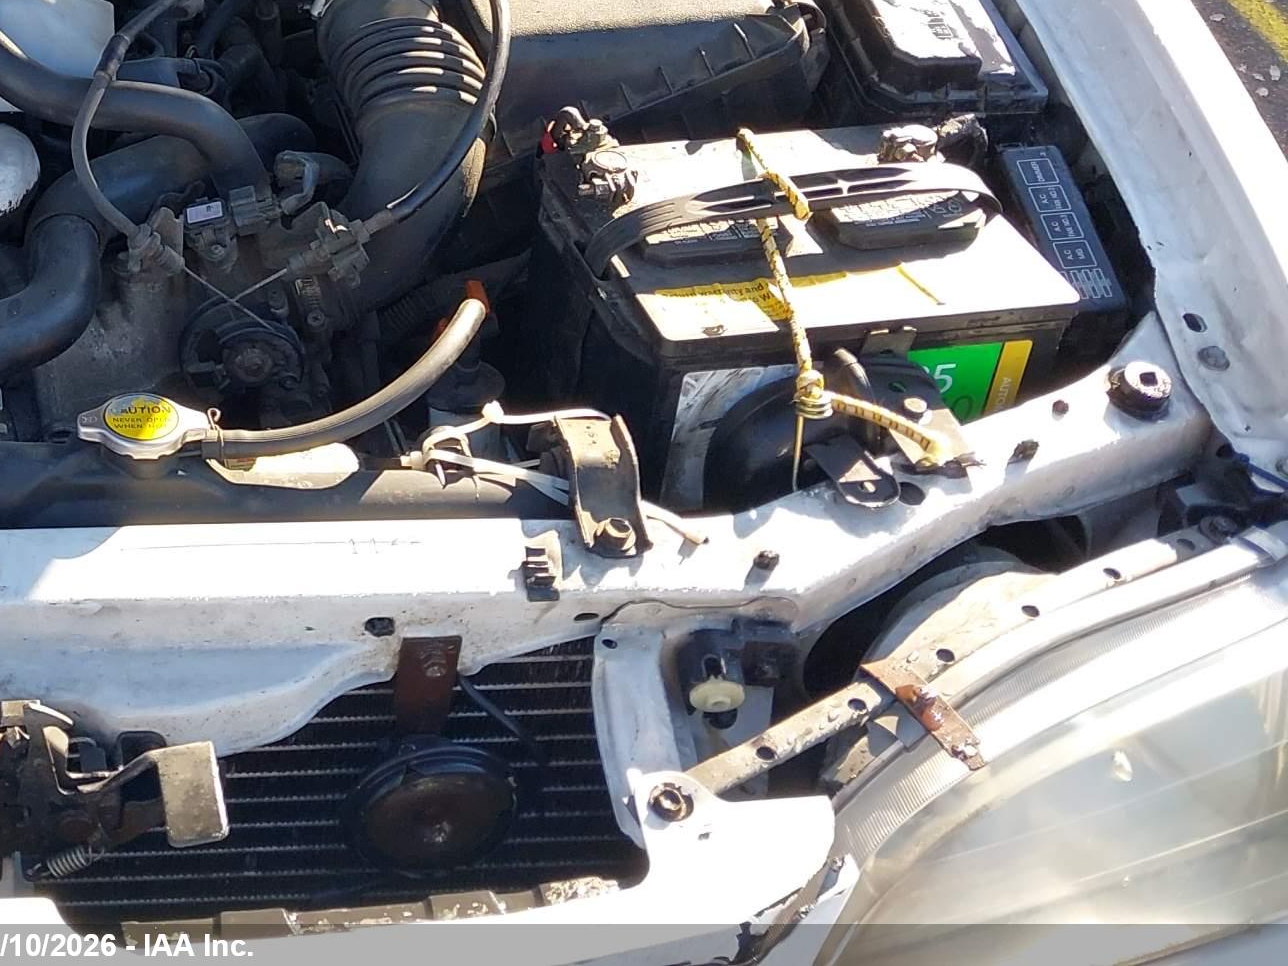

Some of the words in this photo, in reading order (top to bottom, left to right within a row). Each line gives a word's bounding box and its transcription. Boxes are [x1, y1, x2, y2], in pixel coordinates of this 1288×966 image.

[1030, 161, 1046, 183] DIMMER
[112, 416, 142, 424] NEVER
[113, 422, 143, 430] WHEN
